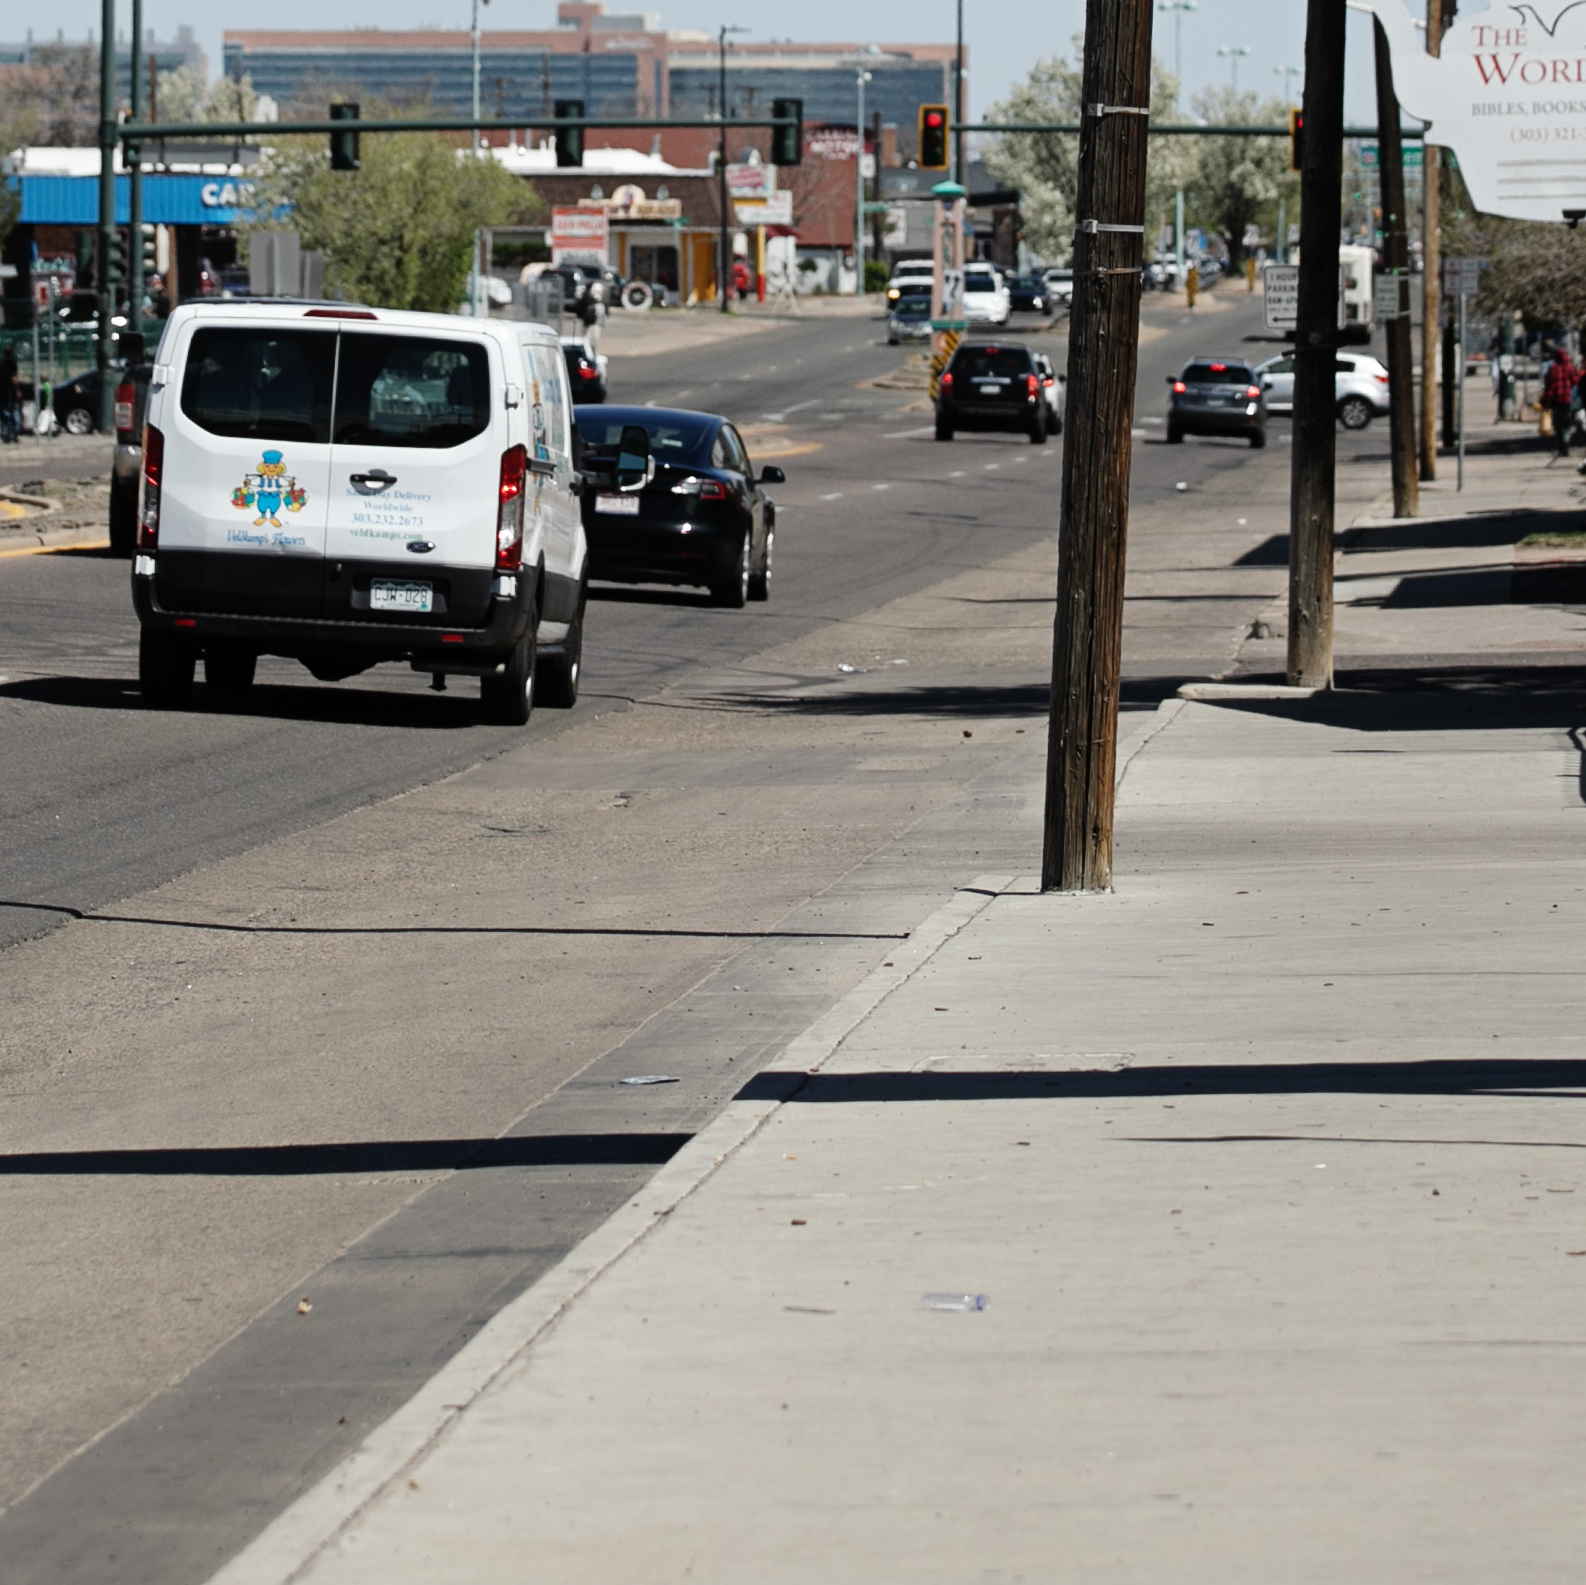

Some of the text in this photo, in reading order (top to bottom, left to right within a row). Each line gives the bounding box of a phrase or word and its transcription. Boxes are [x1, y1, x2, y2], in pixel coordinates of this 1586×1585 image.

[1471, 101, 1529, 116] BIBLES,
[1510, 125, 1549, 144] (303)
[1267, 284, 1297, 292] PARKIN
[394, 490, 432, 502] Delivery
[364, 501, 414, 513] Worldwide
[351, 512, 424, 527] 303.232.2673
[350, 528, 423, 541] veldkamps.com
